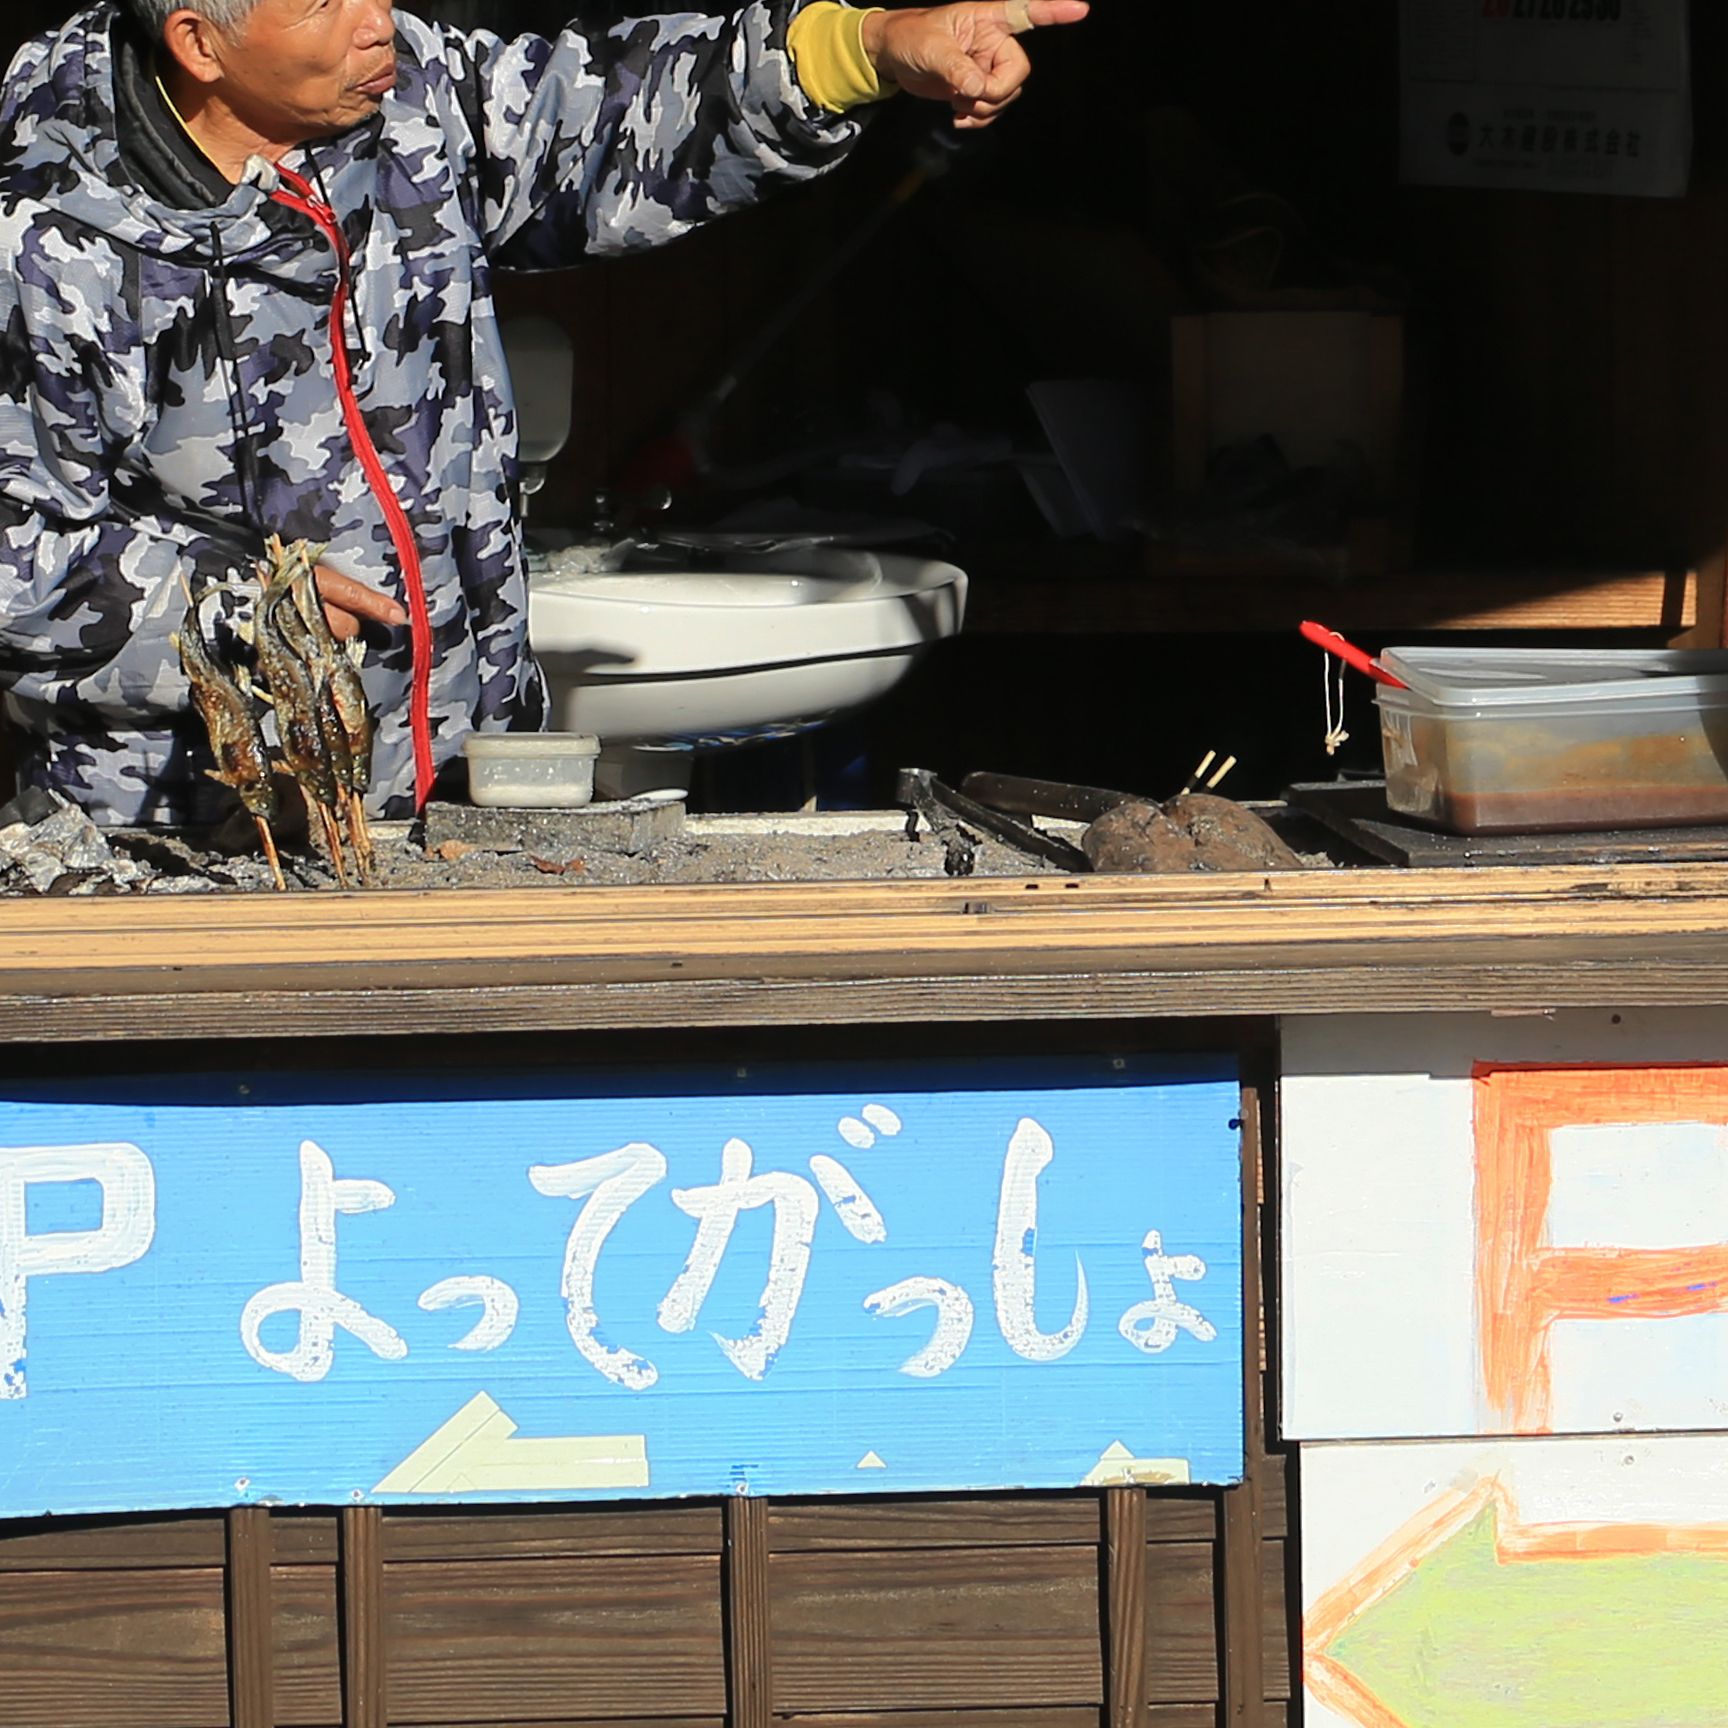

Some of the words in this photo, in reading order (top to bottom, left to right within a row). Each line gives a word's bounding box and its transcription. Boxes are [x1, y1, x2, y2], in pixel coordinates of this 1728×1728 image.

[239, 1103, 1219, 1390] よってがっしょ
